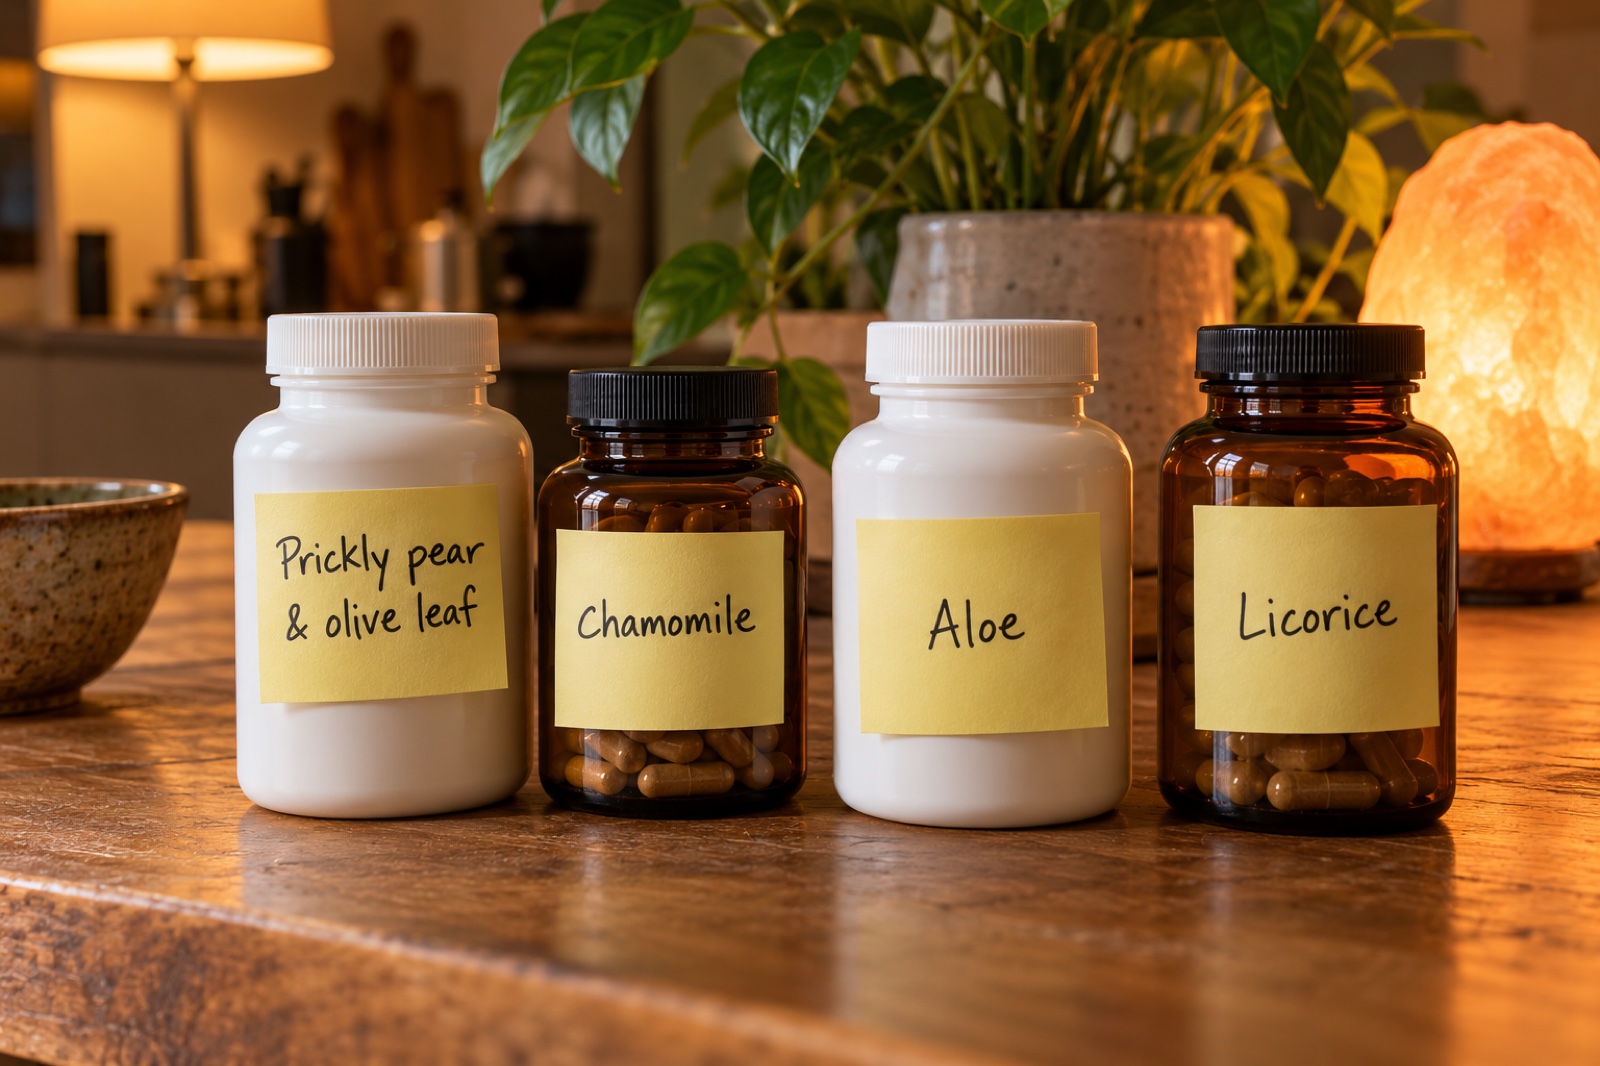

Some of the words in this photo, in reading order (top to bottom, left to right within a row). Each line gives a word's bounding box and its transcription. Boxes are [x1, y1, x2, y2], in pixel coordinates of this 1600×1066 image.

[275, 533, 390, 592] Prickly
[407, 541, 486, 587] pear
[285, 603, 308, 642] &
[325, 597, 402, 641] olive
[416, 583, 479, 633] leaf
[577, 592, 757, 639] Chamomile
[928, 598, 1026, 651] Aloe
[1239, 591, 1399, 641] Licorice
